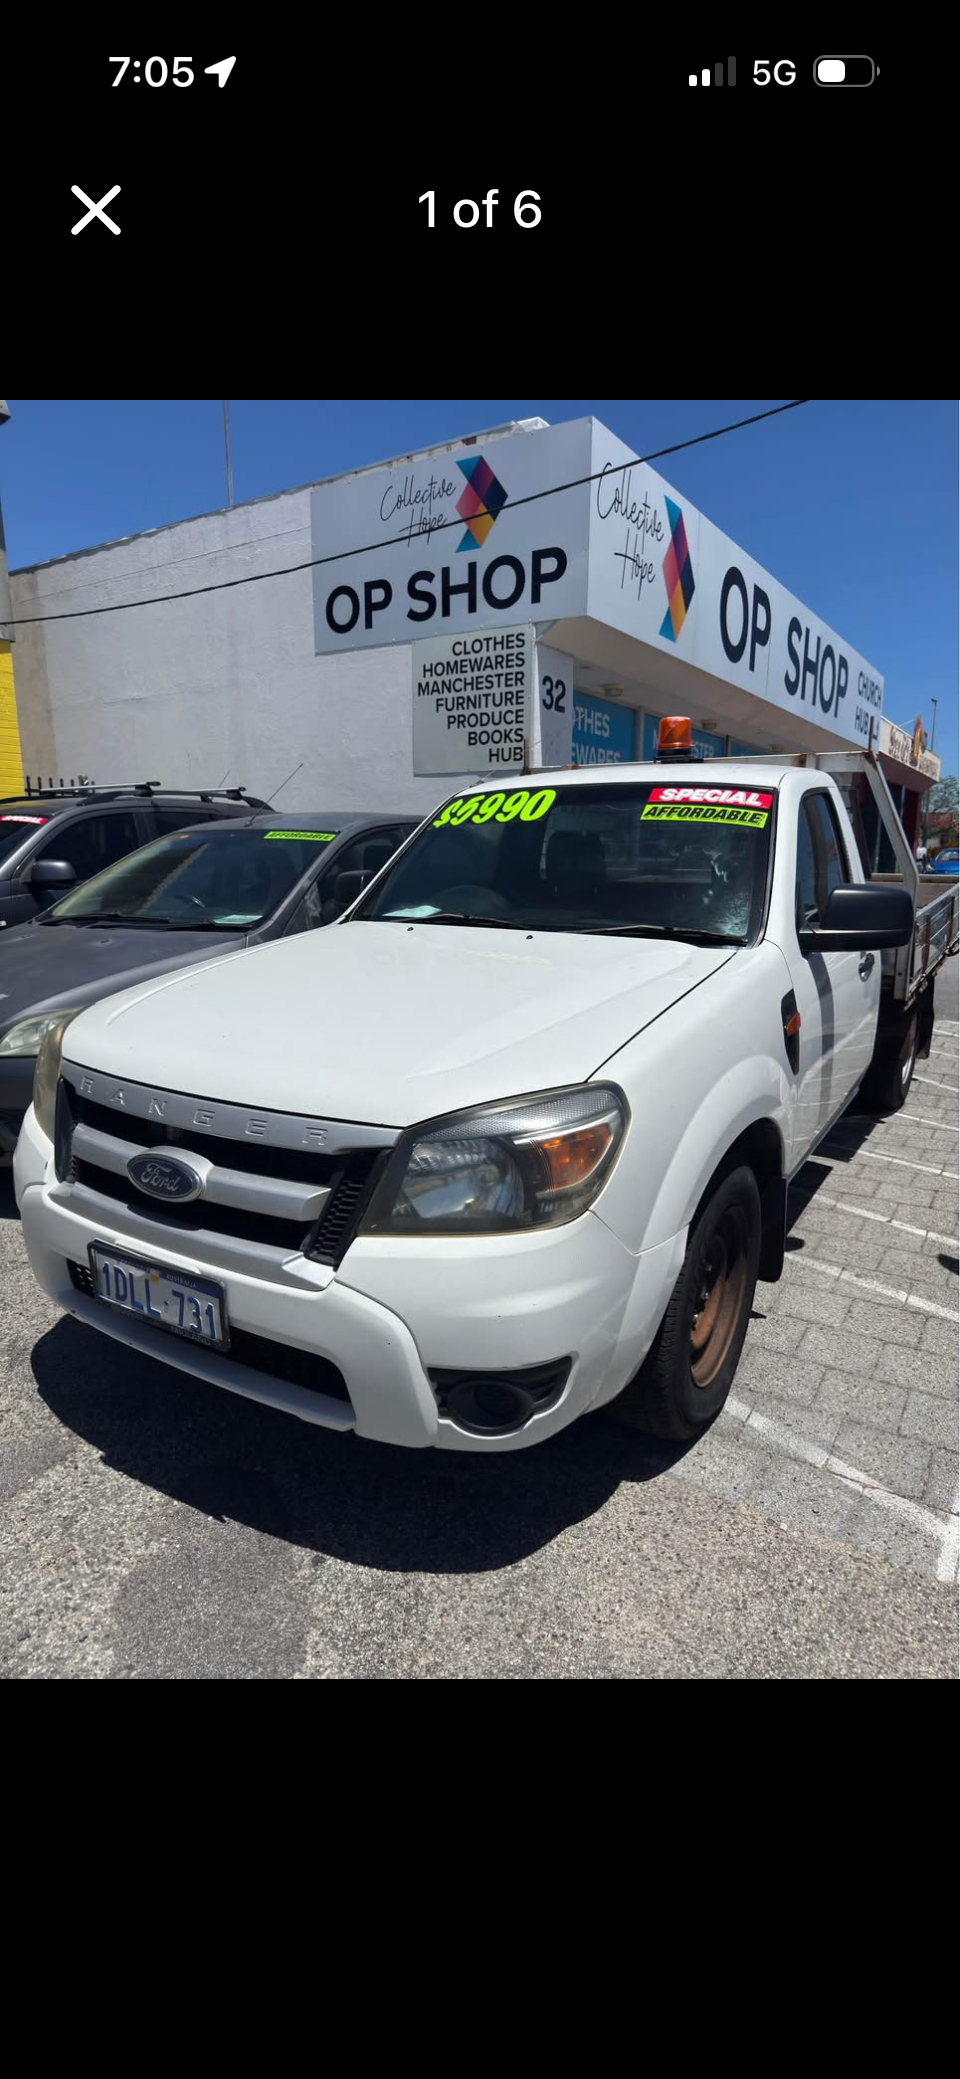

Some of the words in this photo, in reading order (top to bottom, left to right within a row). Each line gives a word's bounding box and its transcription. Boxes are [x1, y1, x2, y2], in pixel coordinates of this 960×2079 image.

[380, 474, 457, 521] Collective
[597, 462, 665, 551] Collective
[398, 506, 448, 547] Hope
[613, 527, 656, 601] Hope
[325, 578, 394, 635] OP
[406, 546, 568, 623] SHOP
[452, 632, 526, 657] CLOTHES
[719, 566, 772, 673] OP
[784, 616, 850, 719] SHOP
[422, 651, 526, 678] HOMEWARES
[417, 671, 526, 697] MANCHESTER
[541, 674, 566, 714] 32
[857, 670, 882, 709] CHURCH
[435, 690, 525, 713] FURNITURE
[447, 708, 525, 730] PRODUCE
[572, 706, 611, 738] THES
[855, 705, 870, 736] HUB
[467, 727, 525, 747] BOOKS
[488, 746, 524, 764] HUB
[433, 789, 557, 829] $5990
[658, 787, 763, 807] SPECIAL
[643, 806, 764, 824] AFFORDABLE
[79, 1075, 329, 1147] RANGER
[139, 1162, 180, 1192] Ford
